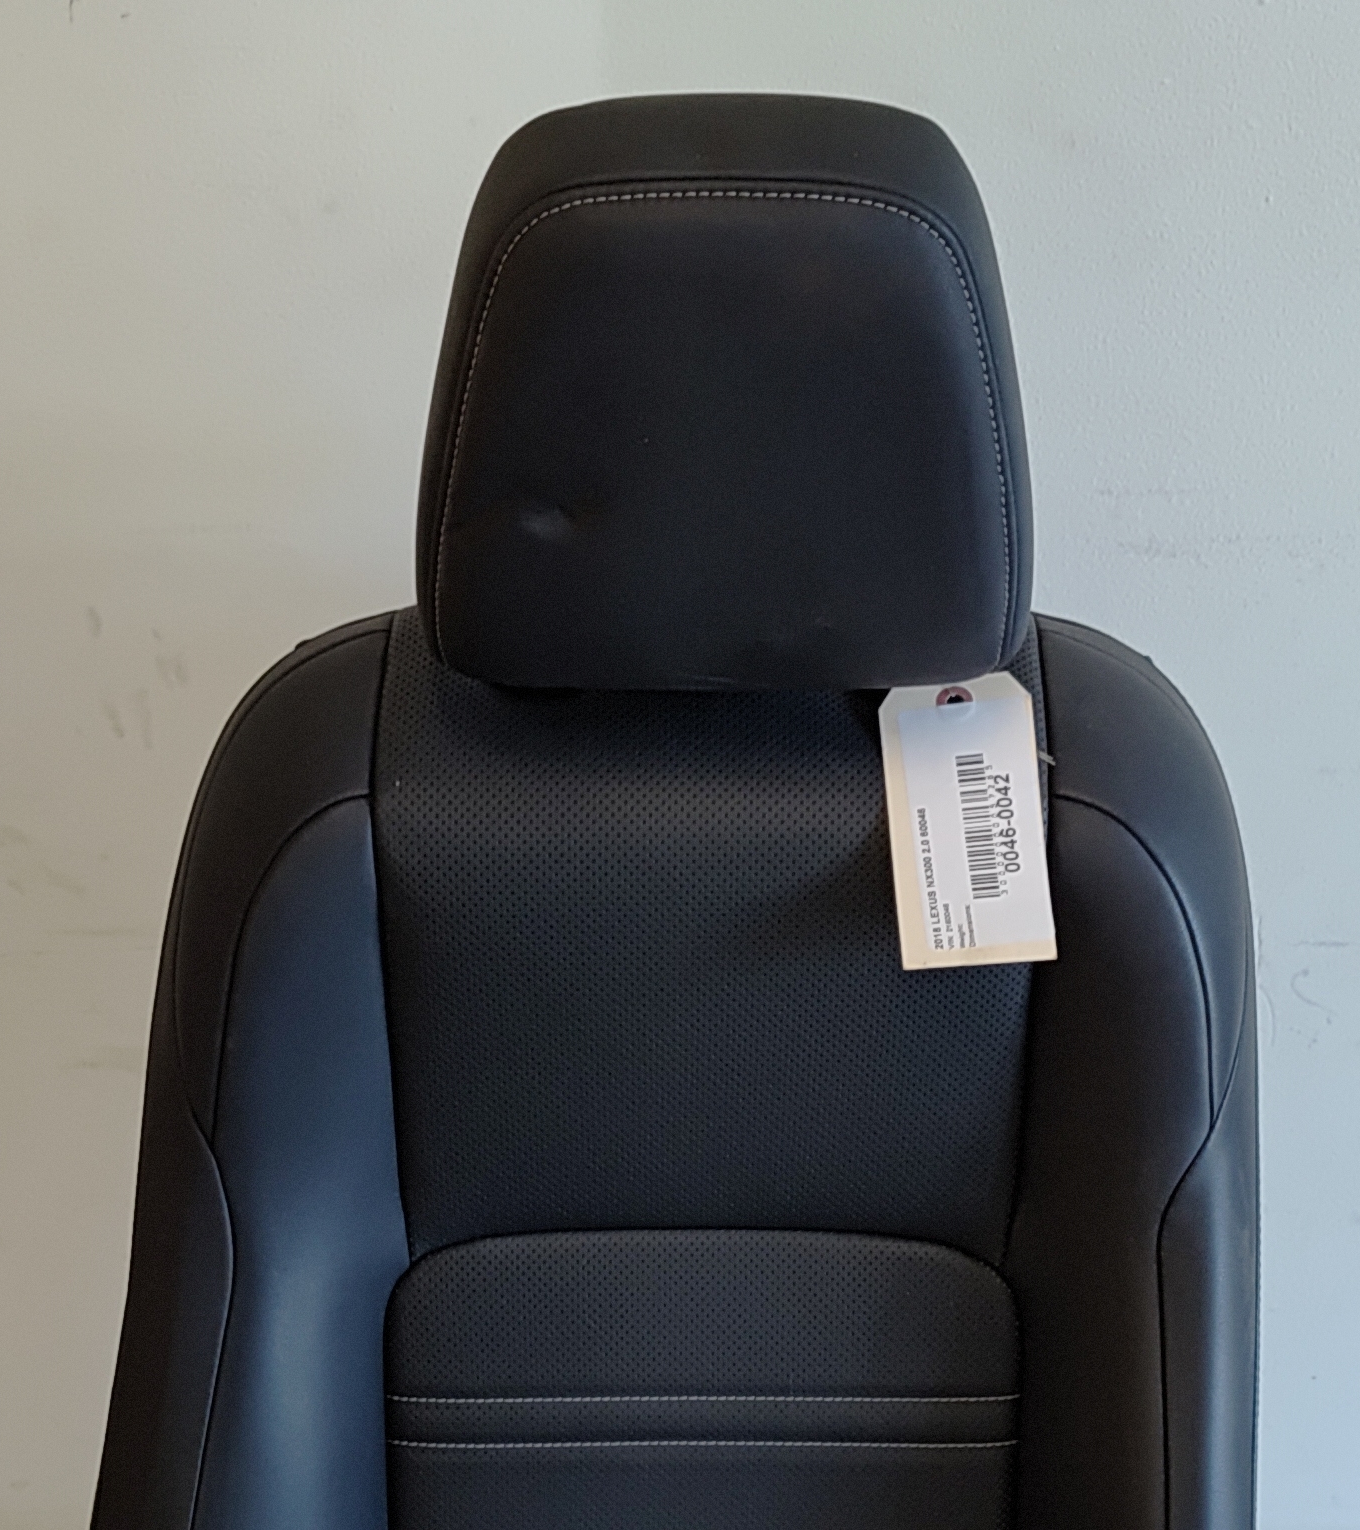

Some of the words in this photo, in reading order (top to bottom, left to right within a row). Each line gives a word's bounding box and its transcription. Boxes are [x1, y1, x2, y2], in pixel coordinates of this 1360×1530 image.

[994, 772, 1021, 873] 0046-0042
[924, 856, 935, 888] NX300
[929, 891, 940, 925] LEXUS
